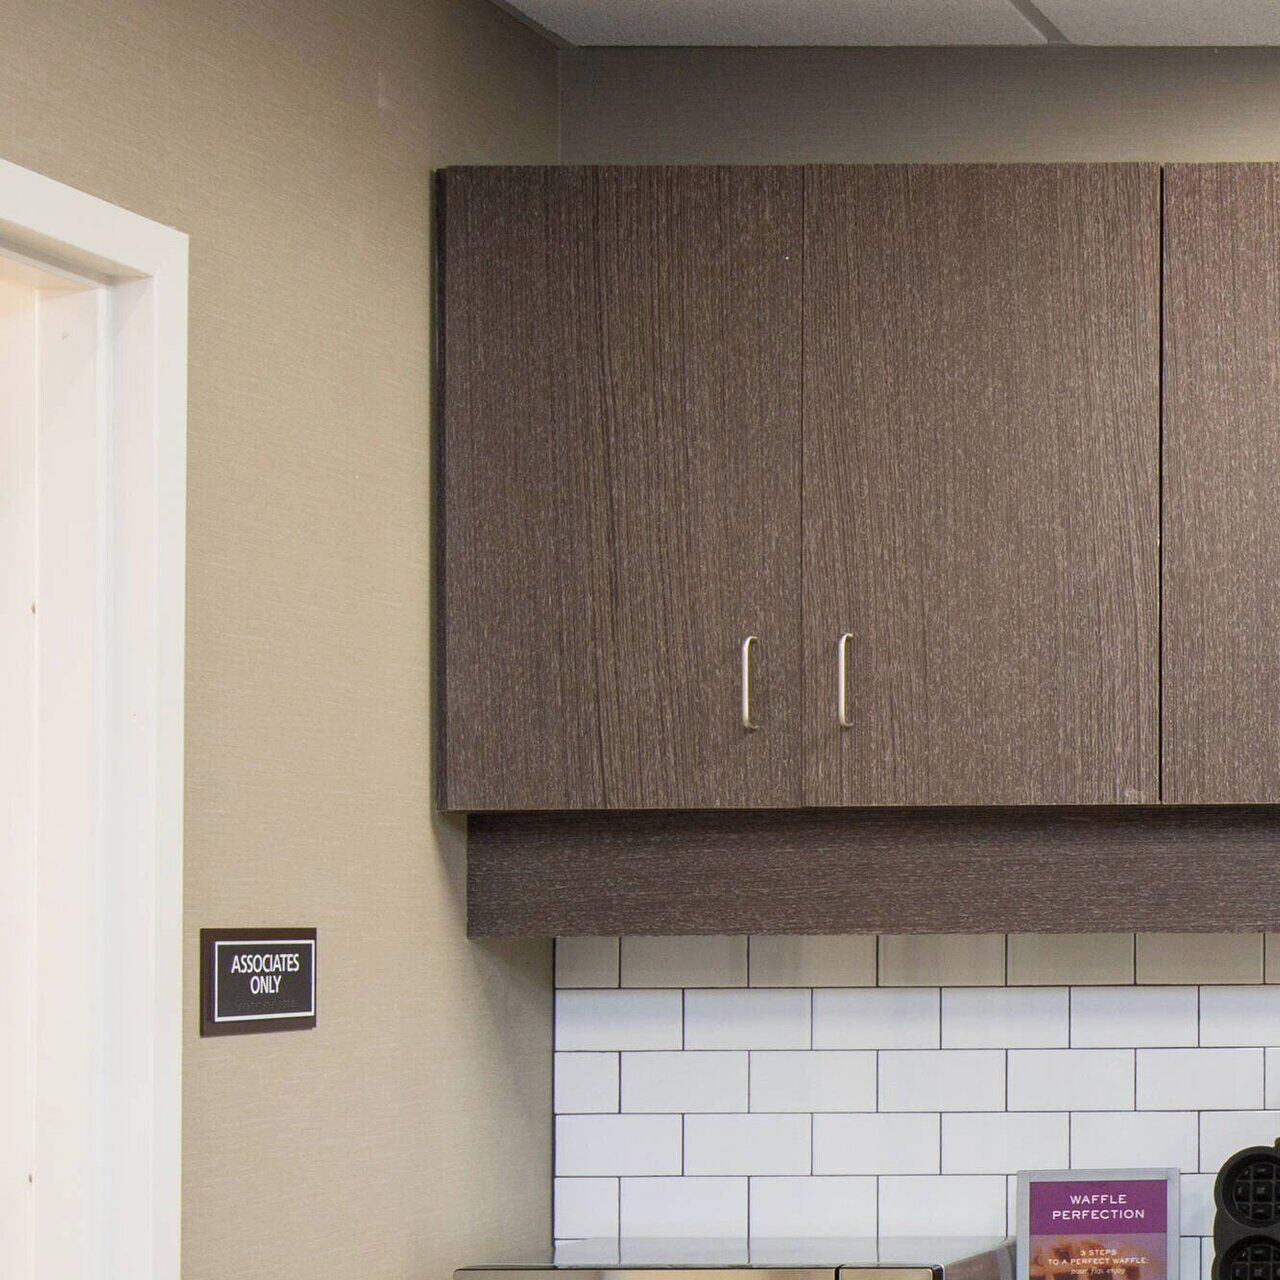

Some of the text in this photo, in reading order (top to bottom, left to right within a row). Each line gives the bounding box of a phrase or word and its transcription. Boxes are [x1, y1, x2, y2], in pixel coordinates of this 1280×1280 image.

[230, 953, 300, 974] ASSOCIATES
[250, 975, 282, 994] ONLY
[1069, 1193, 1127, 1204] WAFFLE
[1052, 1209, 1145, 1220] PERFECTION
